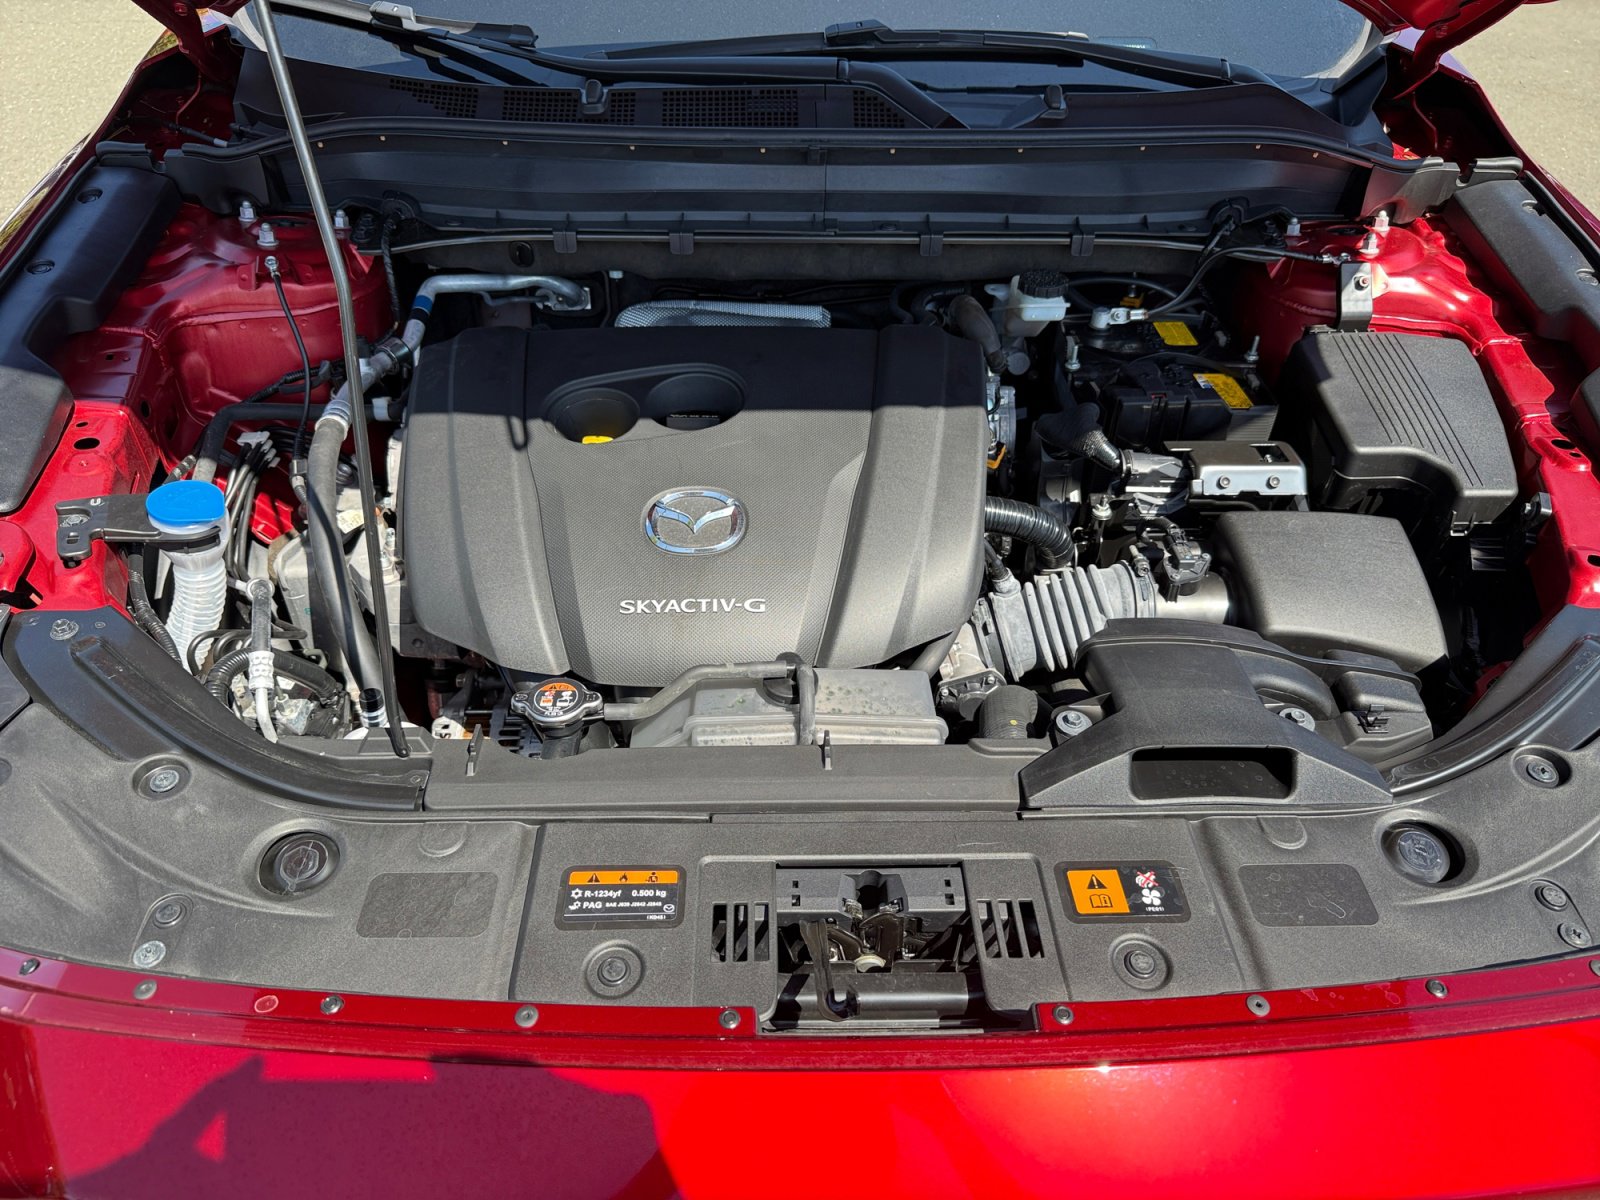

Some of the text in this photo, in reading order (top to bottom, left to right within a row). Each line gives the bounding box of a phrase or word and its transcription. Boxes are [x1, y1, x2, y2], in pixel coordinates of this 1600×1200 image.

[619, 598, 766, 614] SKYACTIV-G
[584, 889, 667, 898] R-1234yf 0.500 kg
[582, 901, 603, 909] PAG
